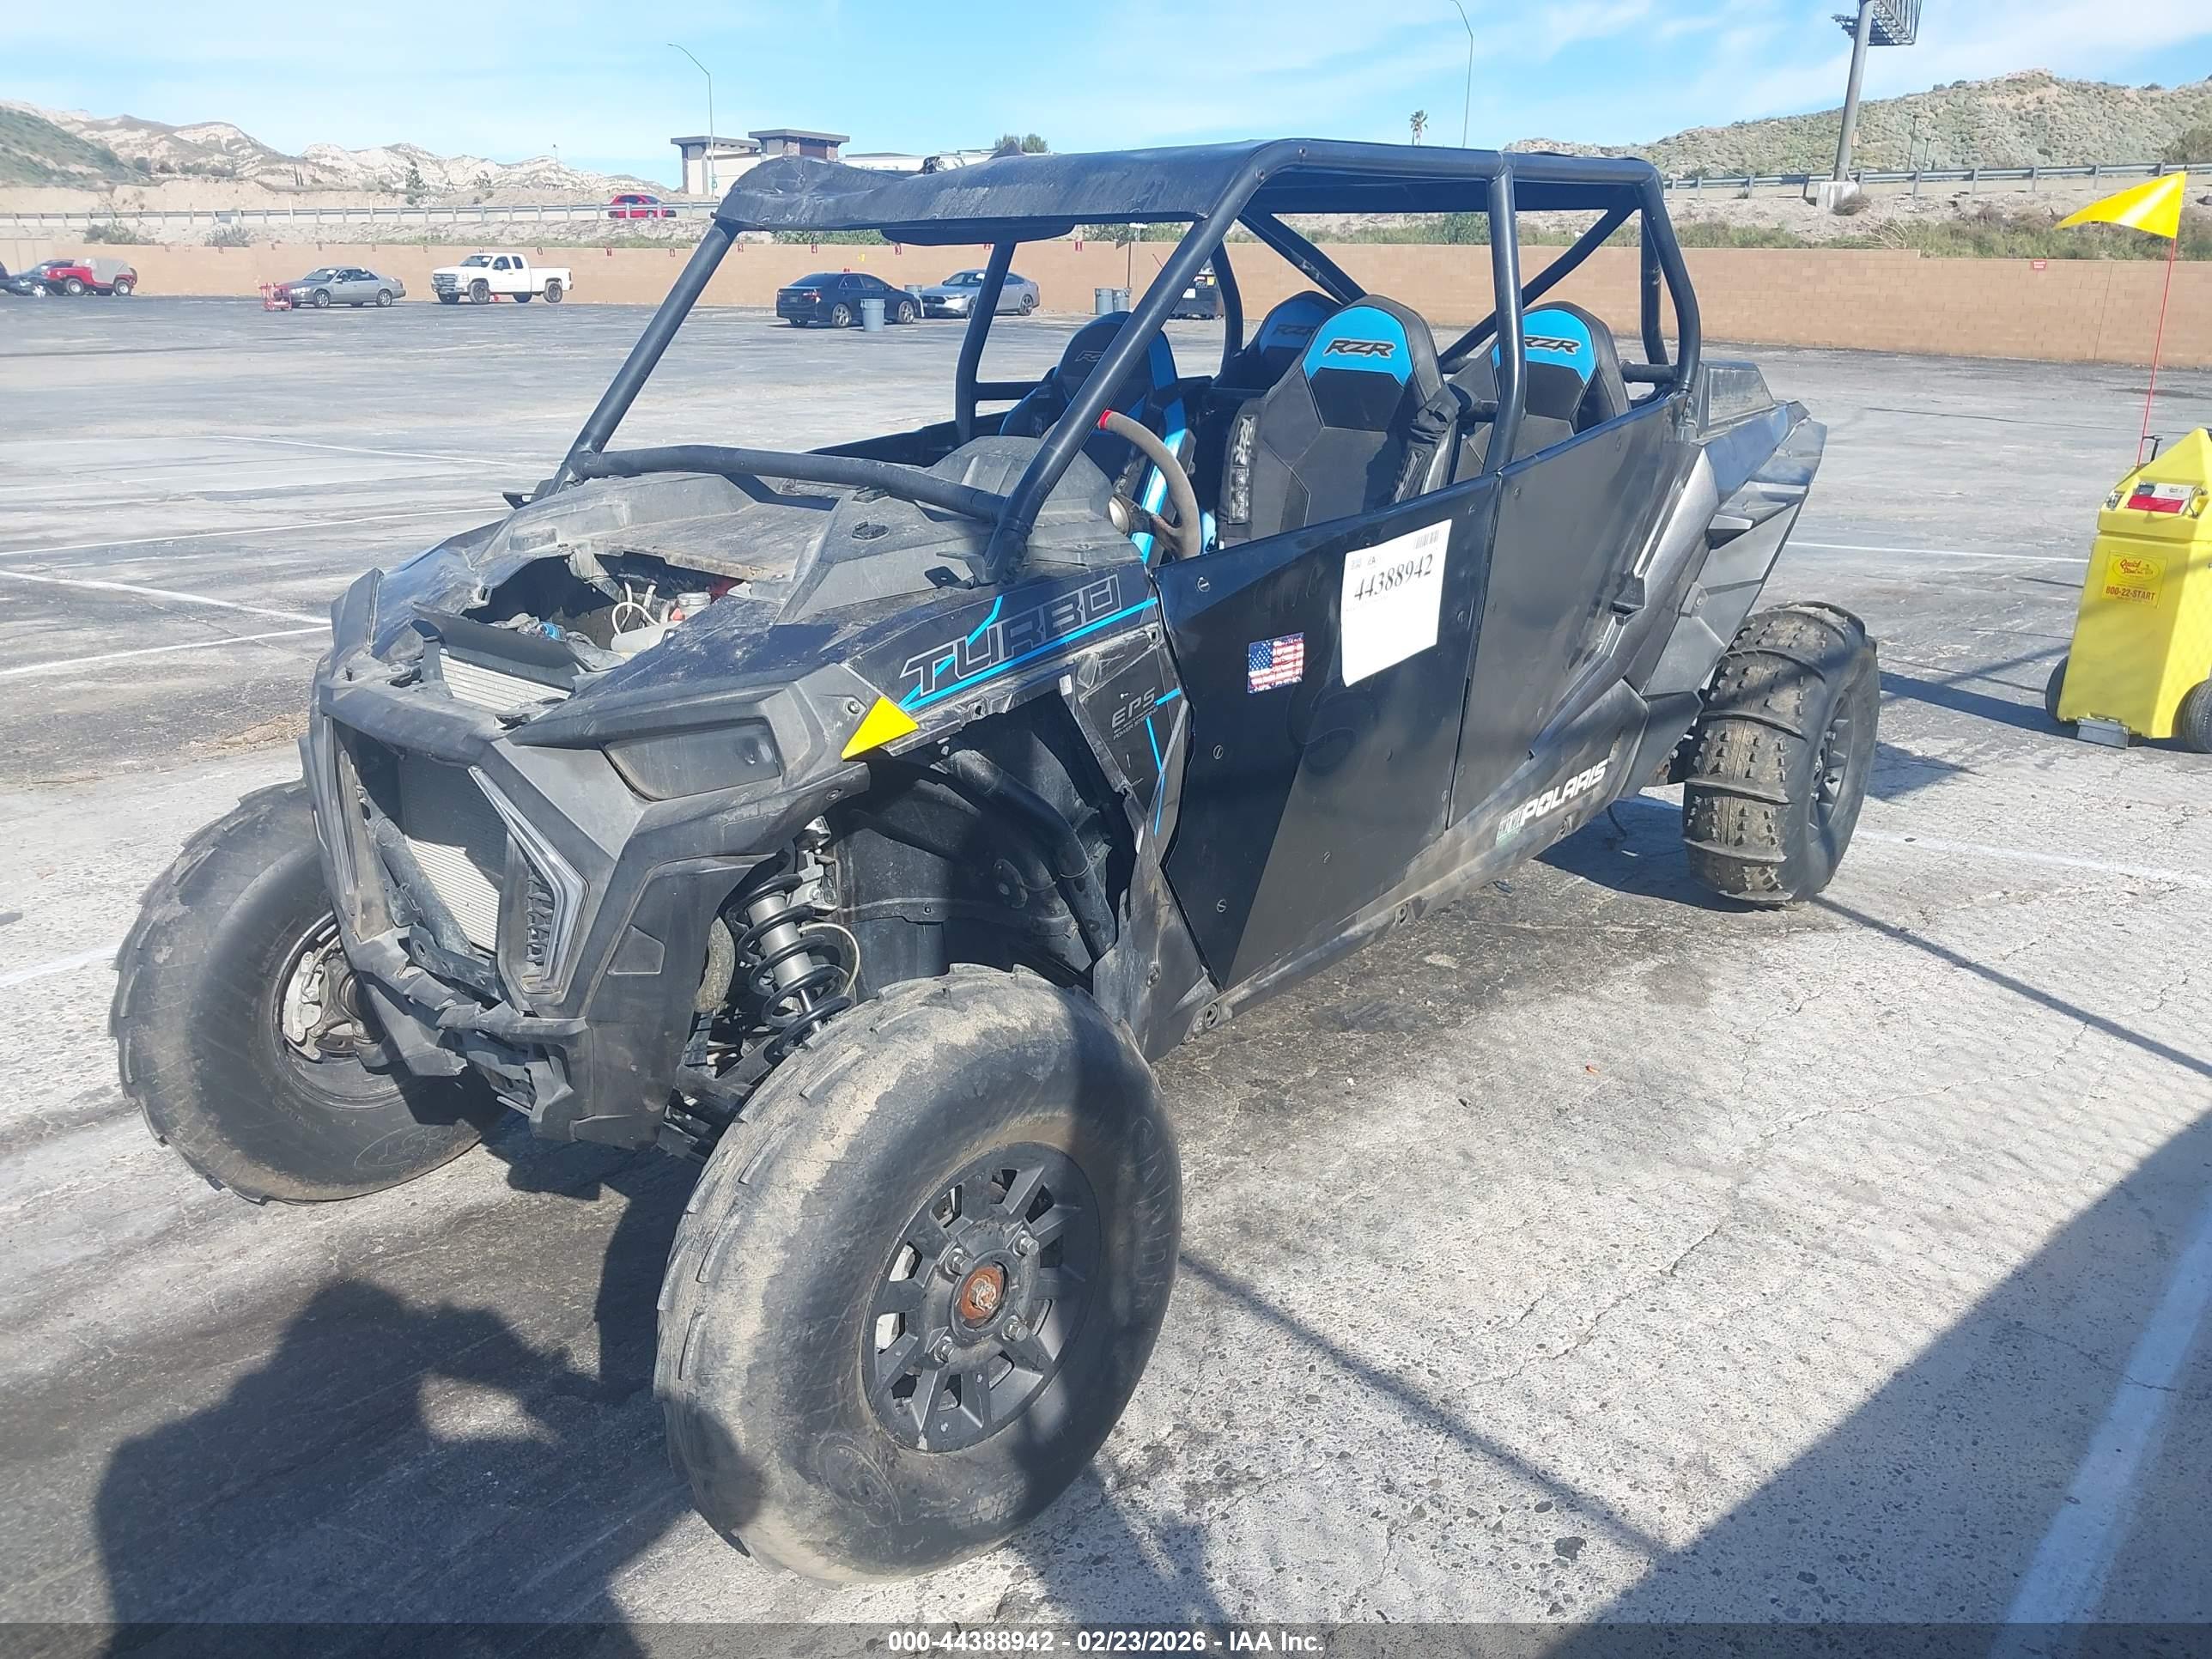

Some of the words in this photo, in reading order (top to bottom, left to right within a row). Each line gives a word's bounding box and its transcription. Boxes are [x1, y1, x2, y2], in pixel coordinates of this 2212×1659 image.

[1324, 339, 1395, 357] RZR
[1354, 553, 1433, 601] 44388942
[899, 574, 1122, 697] TURBO
[1112, 686, 1156, 728] EPS
[1520, 758, 1609, 826] POLARIS
